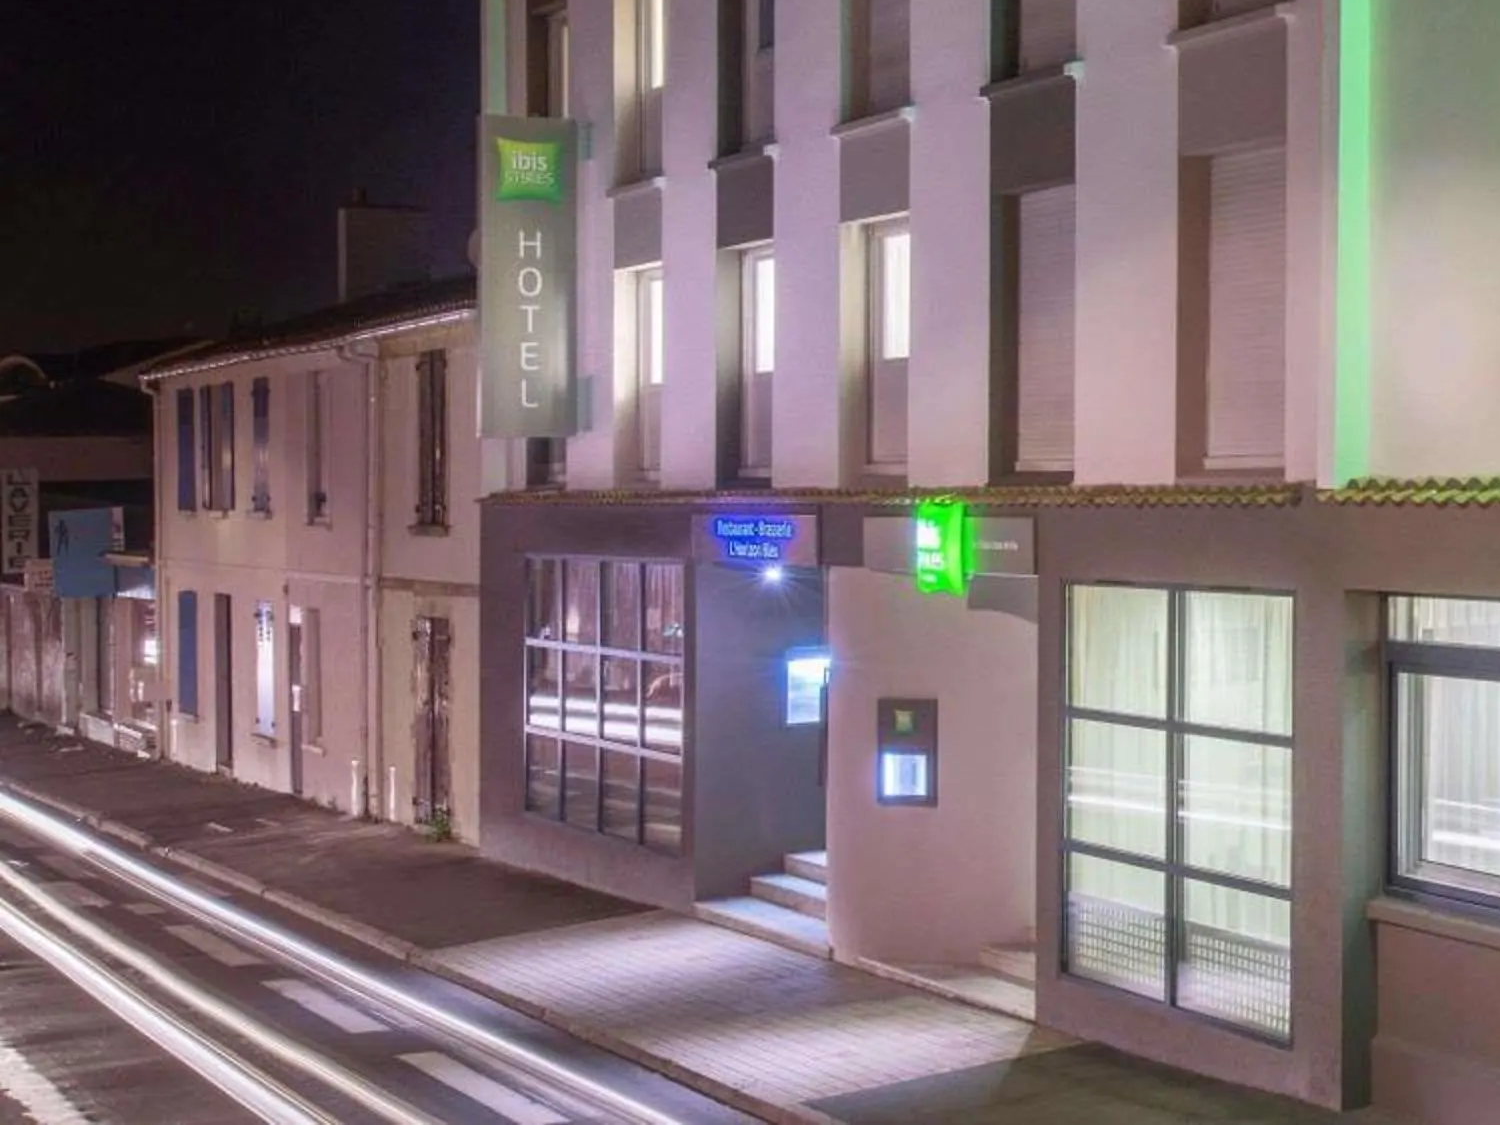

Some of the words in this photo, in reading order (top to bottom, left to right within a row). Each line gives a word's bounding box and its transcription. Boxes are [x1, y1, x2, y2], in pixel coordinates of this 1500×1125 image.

[512, 150, 548, 172] ibis
[517, 229, 543, 409] HOTEL
[7, 473, 34, 569] LAVERIE
